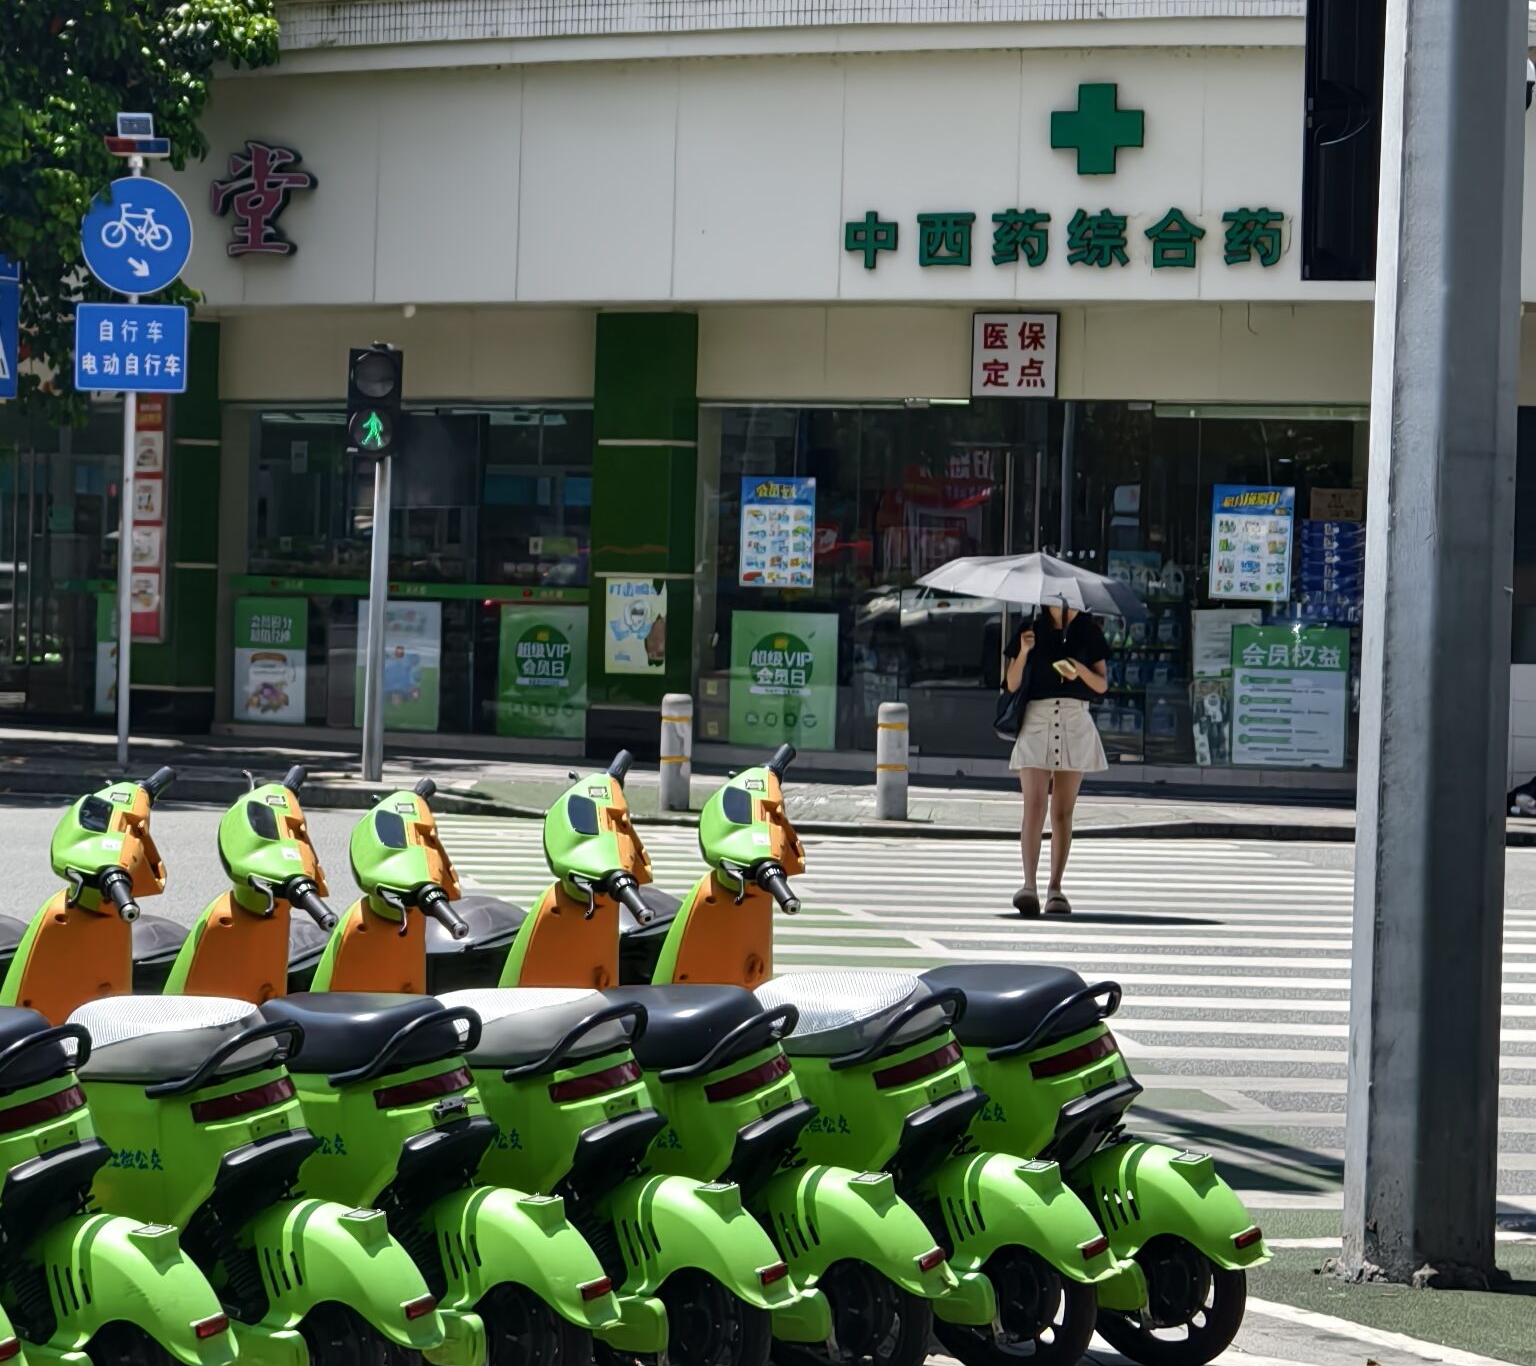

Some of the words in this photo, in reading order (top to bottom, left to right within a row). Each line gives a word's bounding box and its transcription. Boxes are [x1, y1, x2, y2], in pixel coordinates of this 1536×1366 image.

[211, 140, 315, 256] 堂
[845, 206, 1284, 270] 中西药综合药
[99, 319, 164, 343] 自行车
[982, 321, 1047, 351] 医保
[82, 352, 181, 377] 电动自行车
[982, 358, 1046, 389] 定点
[750, 650, 814, 667] 超级VIP
[1242, 643, 1341, 668] 会员权益
[755, 667, 806, 686] 会员日
